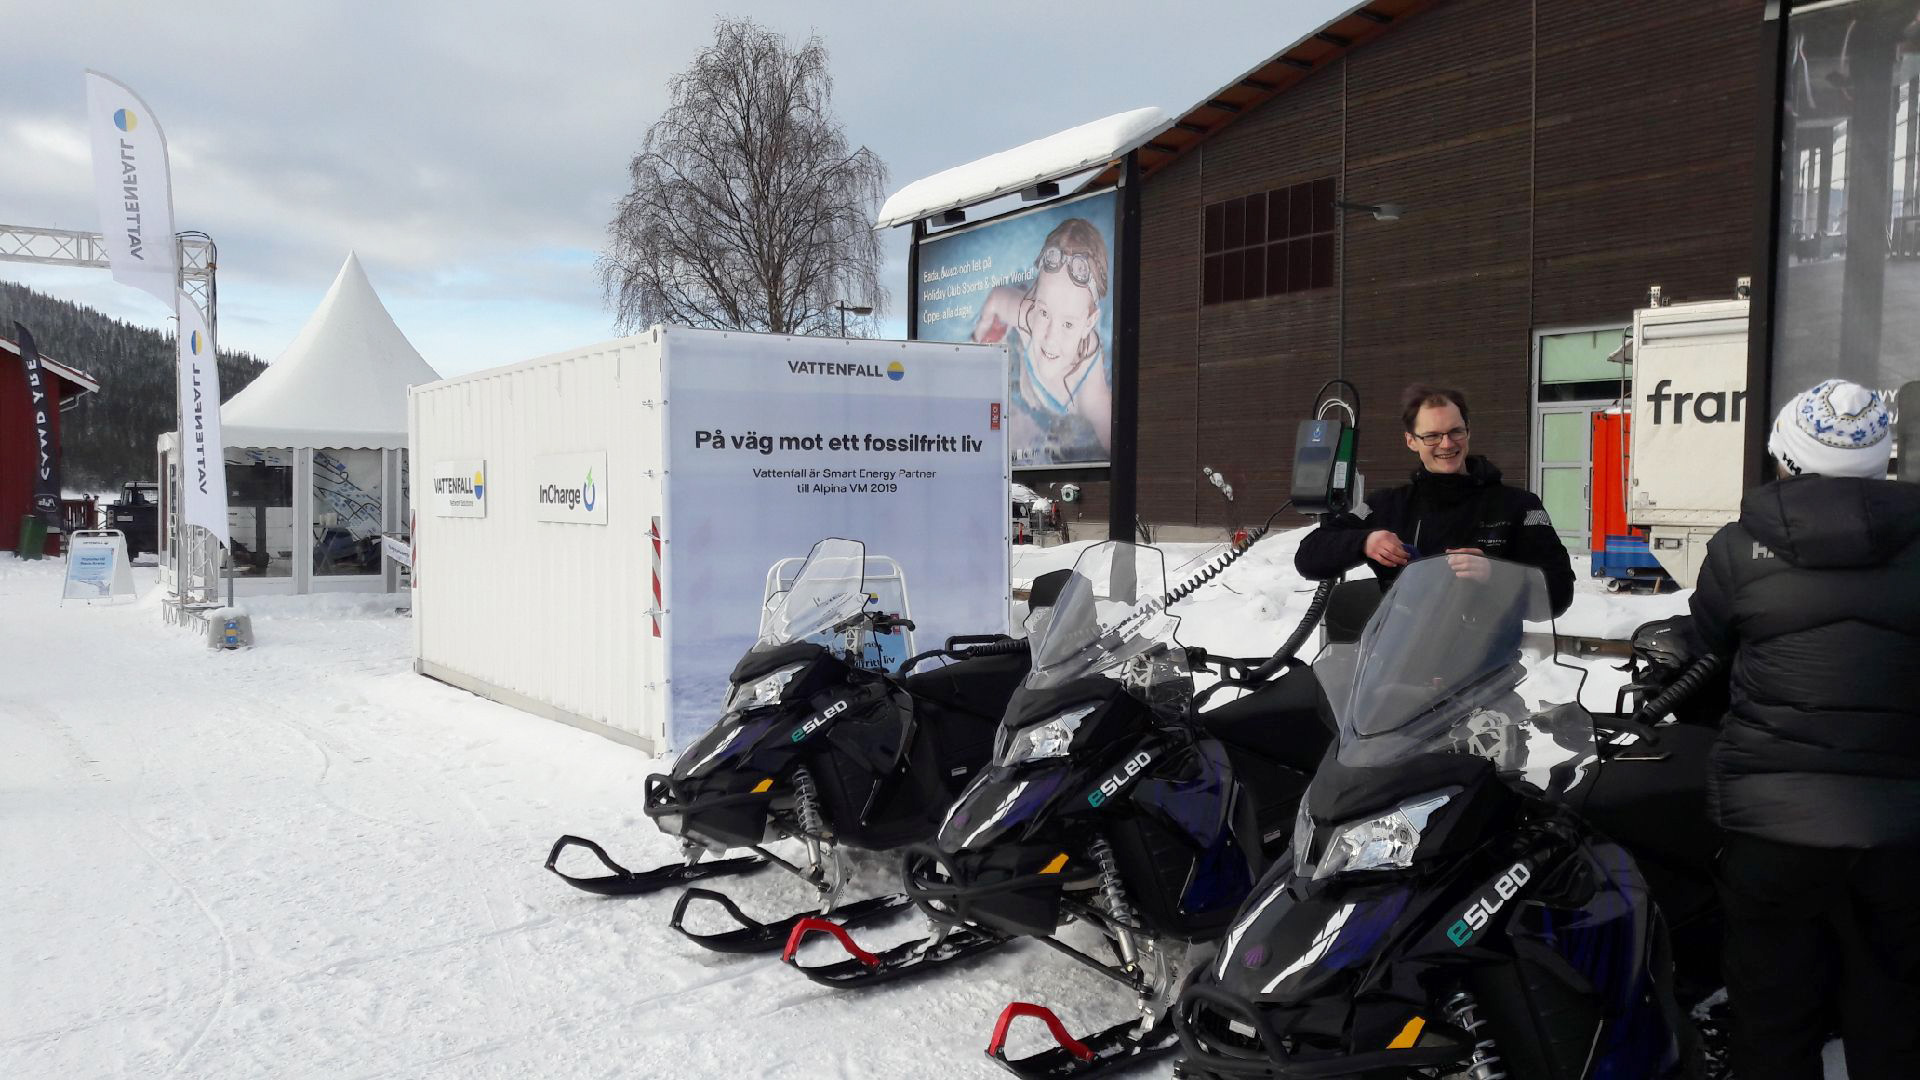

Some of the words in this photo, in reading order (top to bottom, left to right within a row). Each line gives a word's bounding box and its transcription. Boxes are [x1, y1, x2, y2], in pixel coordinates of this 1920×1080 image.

[923, 288, 946, 302] Holiday
[947, 283, 961, 298] Club
[984, 276, 989, 289] &
[1010, 268, 1034, 284] World!
[787, 360, 884, 378] VATTENFALL
[695, 429, 726, 450] På
[731, 431, 773, 456] väg
[779, 433, 824, 451] mot
[828, 434, 860, 451] ett
[863, 434, 957, 452] fossilfritt
[961, 435, 983, 453] liv
[752, 468, 807, 479] Vattenfall
[808, 468, 821, 479] är
[822, 469, 857, 479] Smart
[859, 469, 896, 481] Energy
[899, 470, 937, 480] Partner
[433, 477, 474, 495] VATTENFALL
[797, 483, 809, 494] till
[812, 483, 848, 496] Alpina
[849, 483, 868, 494] VM
[870, 483, 898, 494] 2019
[539, 484, 581, 511] InCharge
